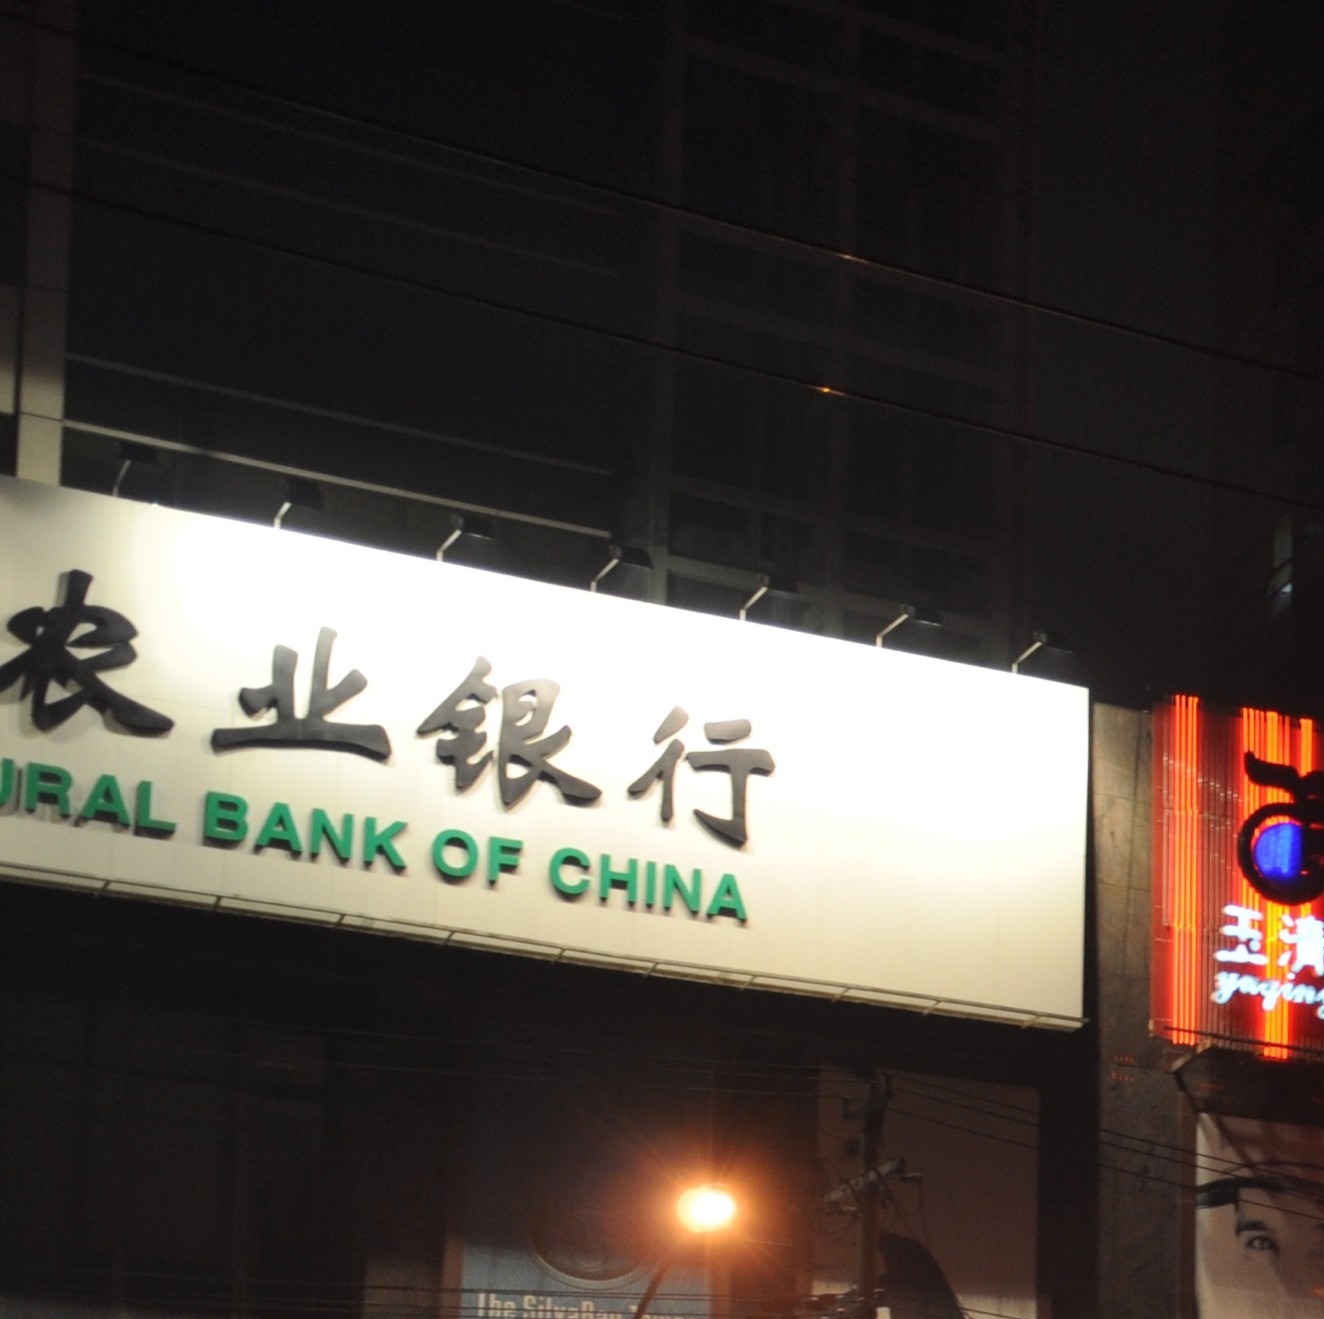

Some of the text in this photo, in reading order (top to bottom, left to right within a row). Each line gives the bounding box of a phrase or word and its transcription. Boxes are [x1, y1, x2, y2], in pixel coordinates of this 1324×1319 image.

[0, 568, 777, 849] 农业银行
[203, 789, 406, 872] BANK
[432, 828, 523, 888] OF
[549, 848, 748, 922] CHINA
